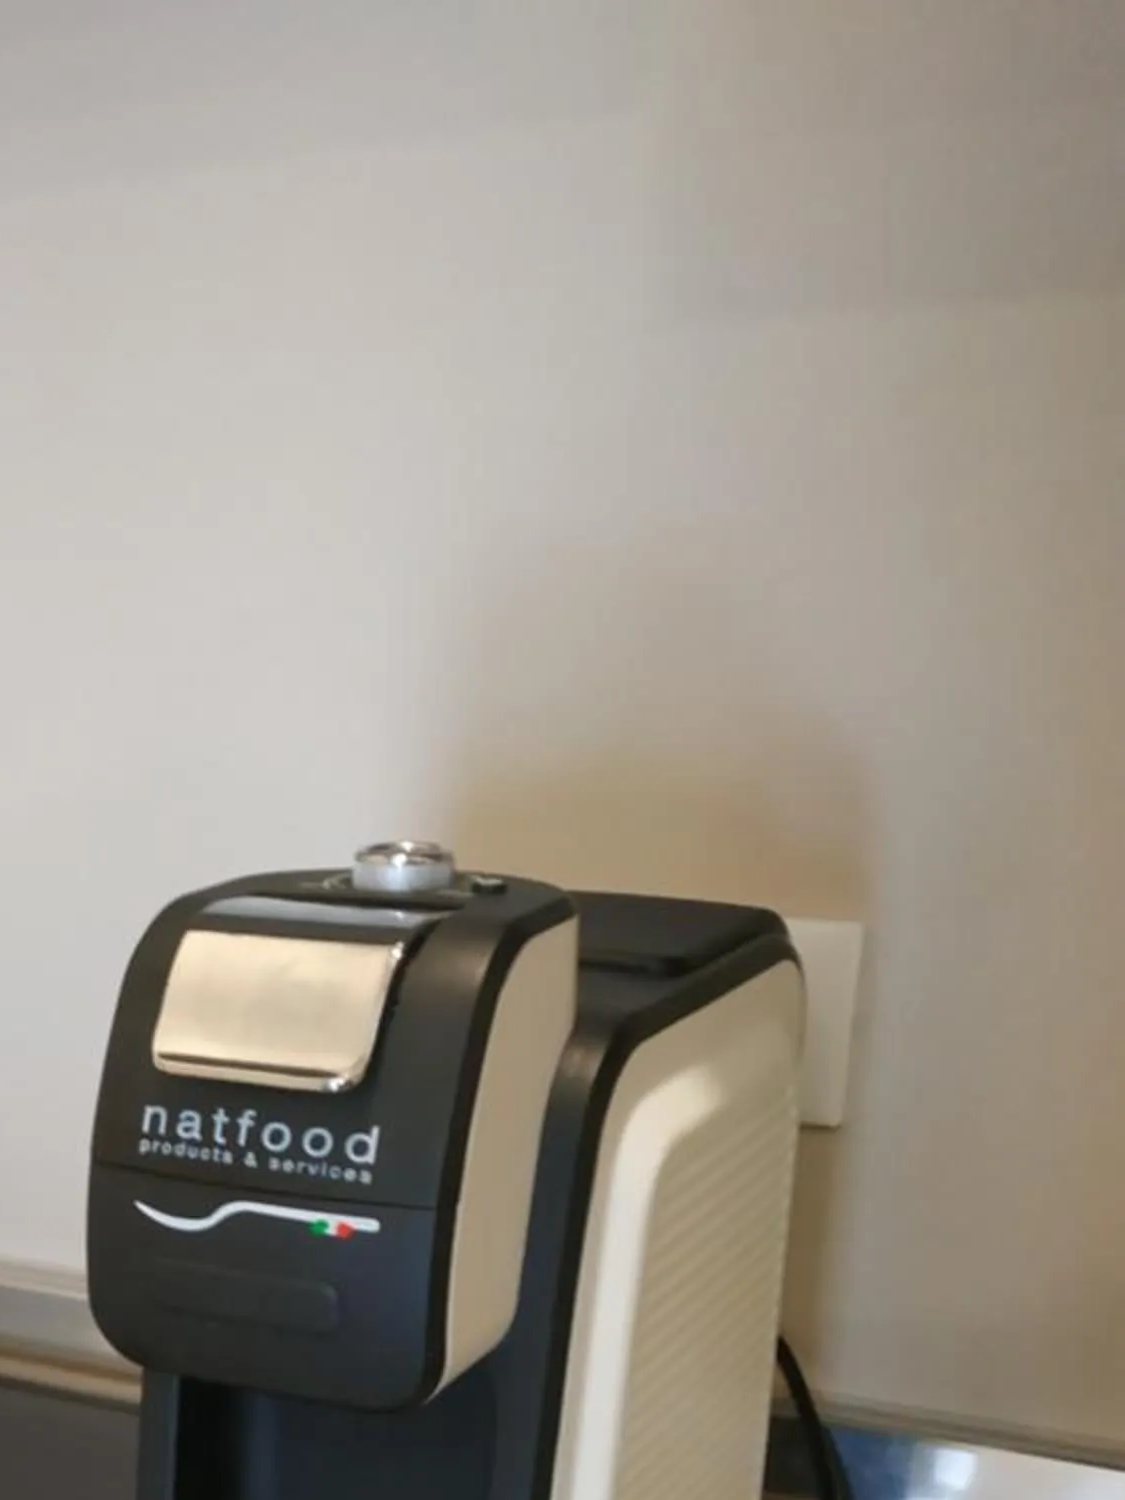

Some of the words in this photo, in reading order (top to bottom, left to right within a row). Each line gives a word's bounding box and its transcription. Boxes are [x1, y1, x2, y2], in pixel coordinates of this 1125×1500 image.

[137, 1136, 233, 1166] products
[243, 1150, 258, 1169] &
[267, 1156, 373, 1186] services
[140, 1103, 381, 1167] natfood
